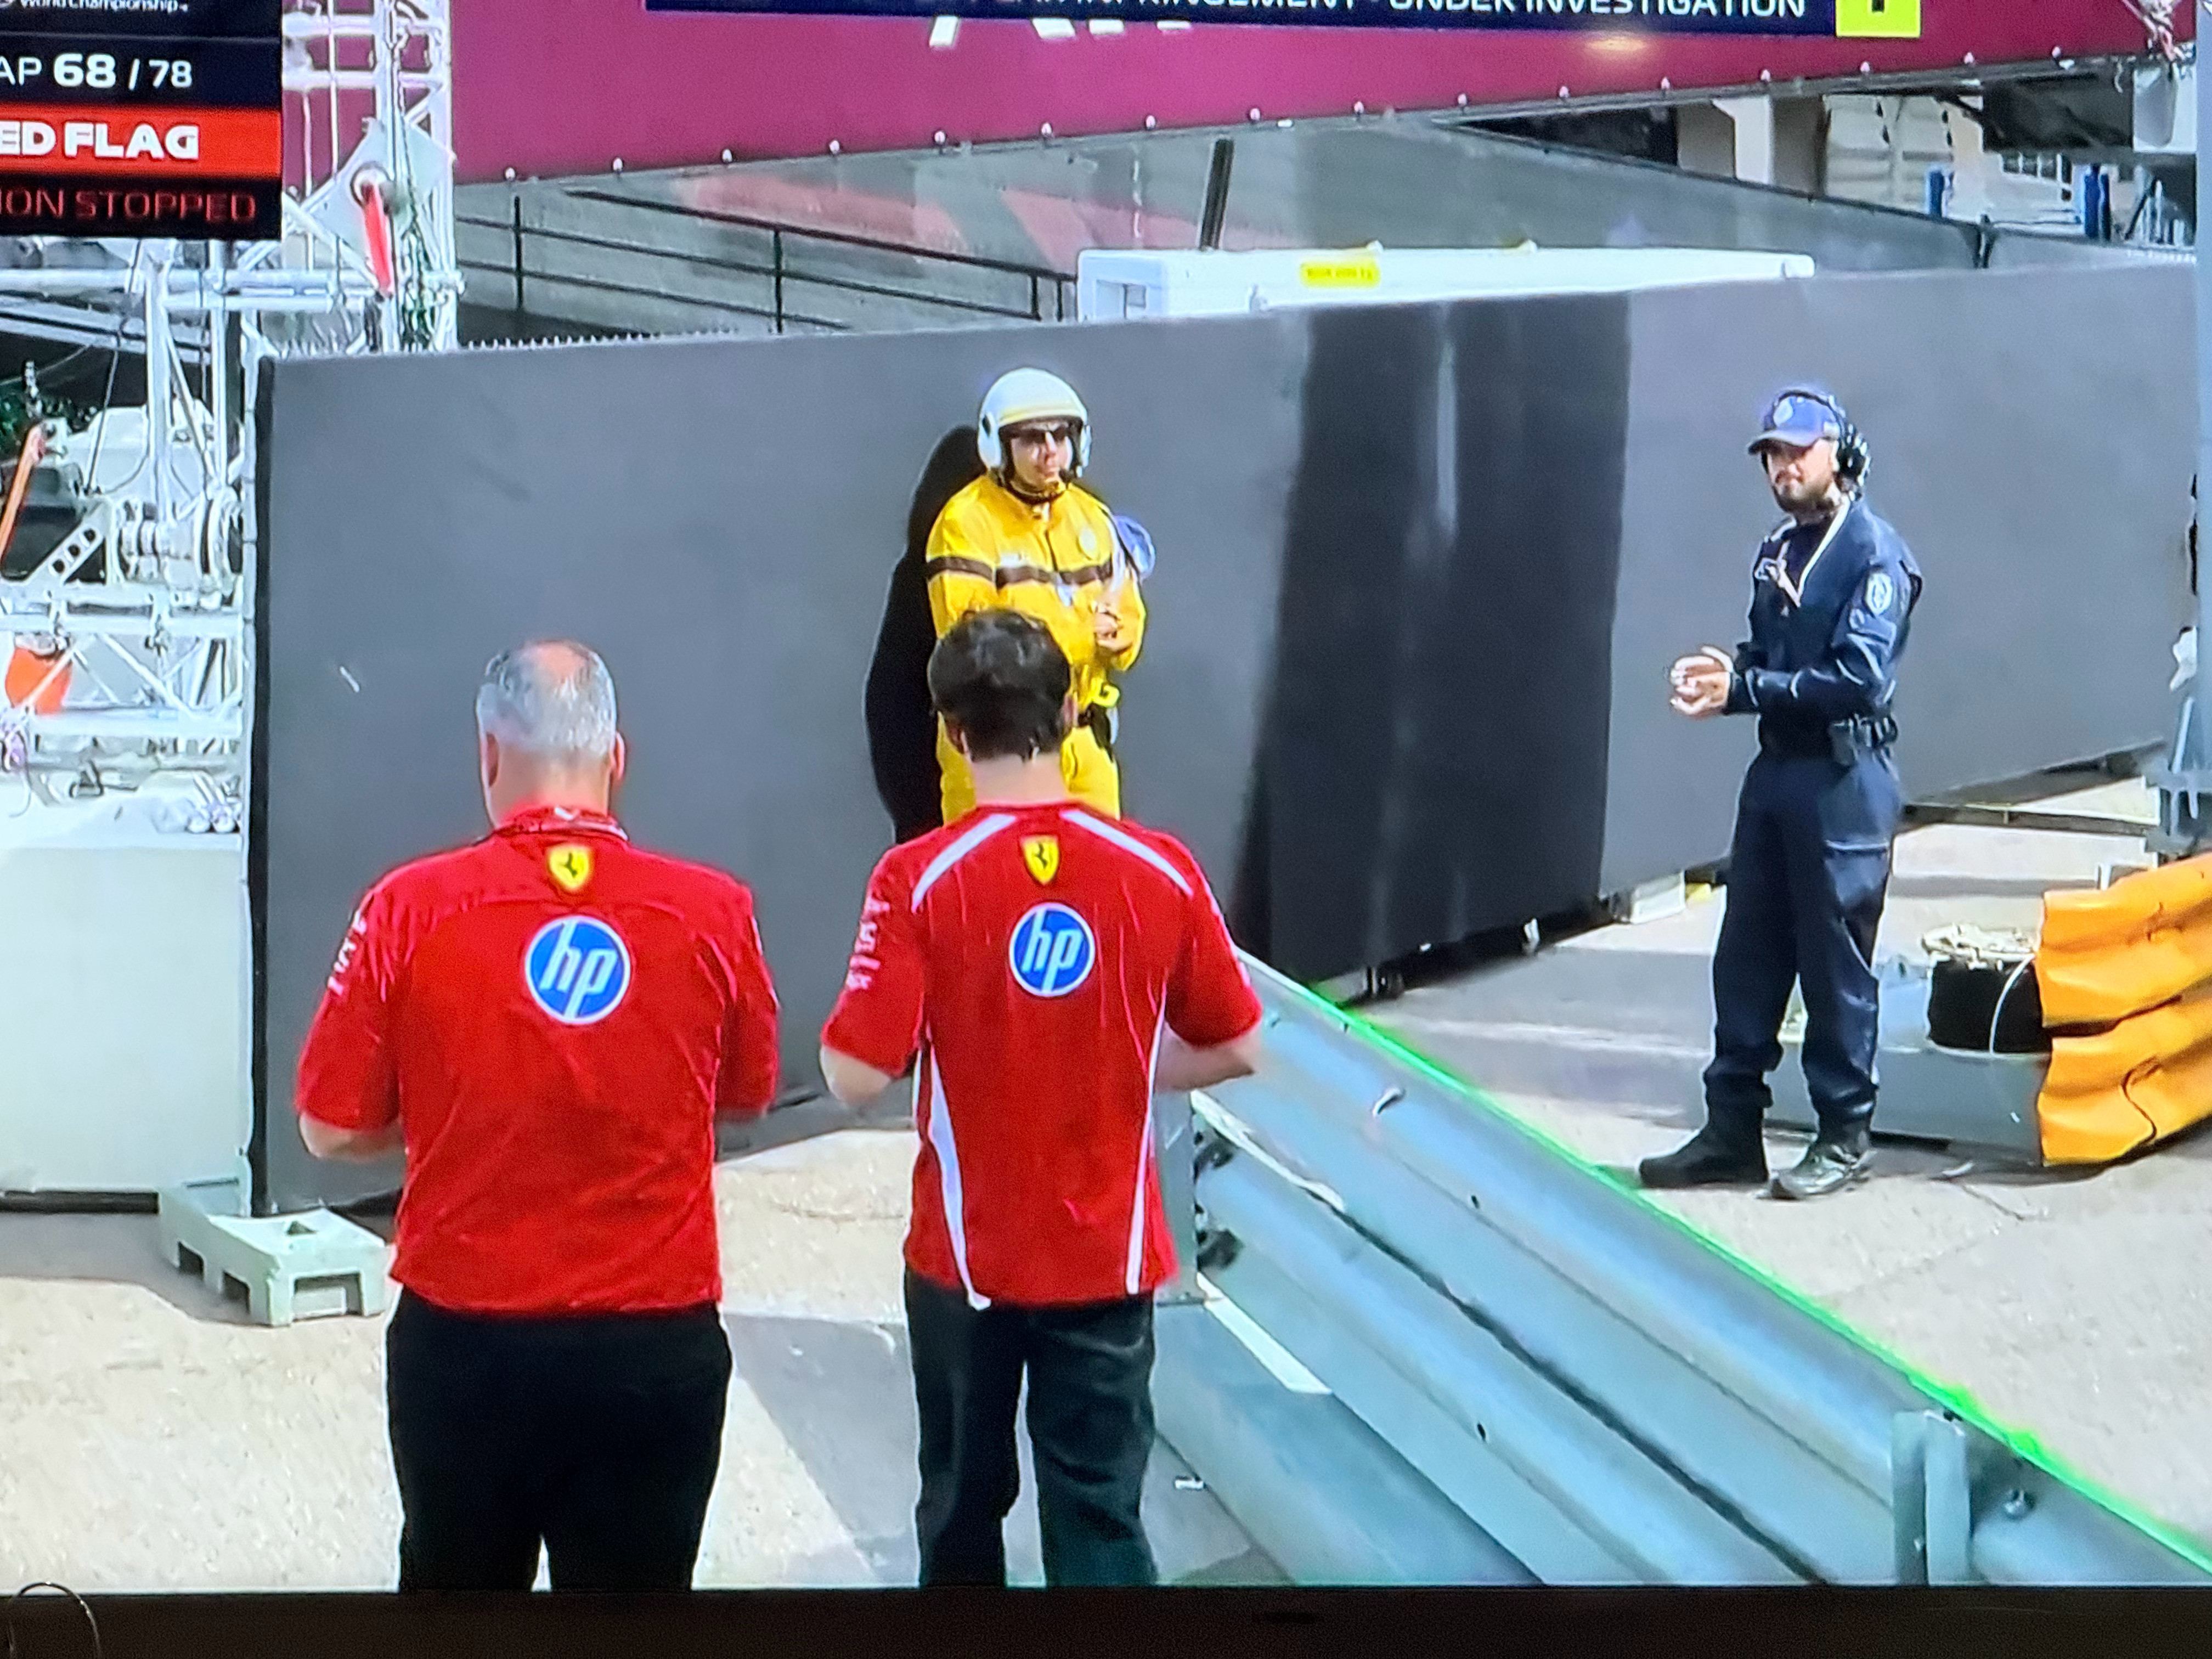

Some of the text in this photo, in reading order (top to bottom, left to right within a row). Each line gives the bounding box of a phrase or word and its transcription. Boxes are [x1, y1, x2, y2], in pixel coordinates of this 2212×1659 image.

[54, 53, 116, 87] 68
[64, 121, 200, 160] FLAG
[75, 190, 256, 222] STOPPED
[1021, 904, 1084, 995] hp
[539, 918, 618, 1022] hp
